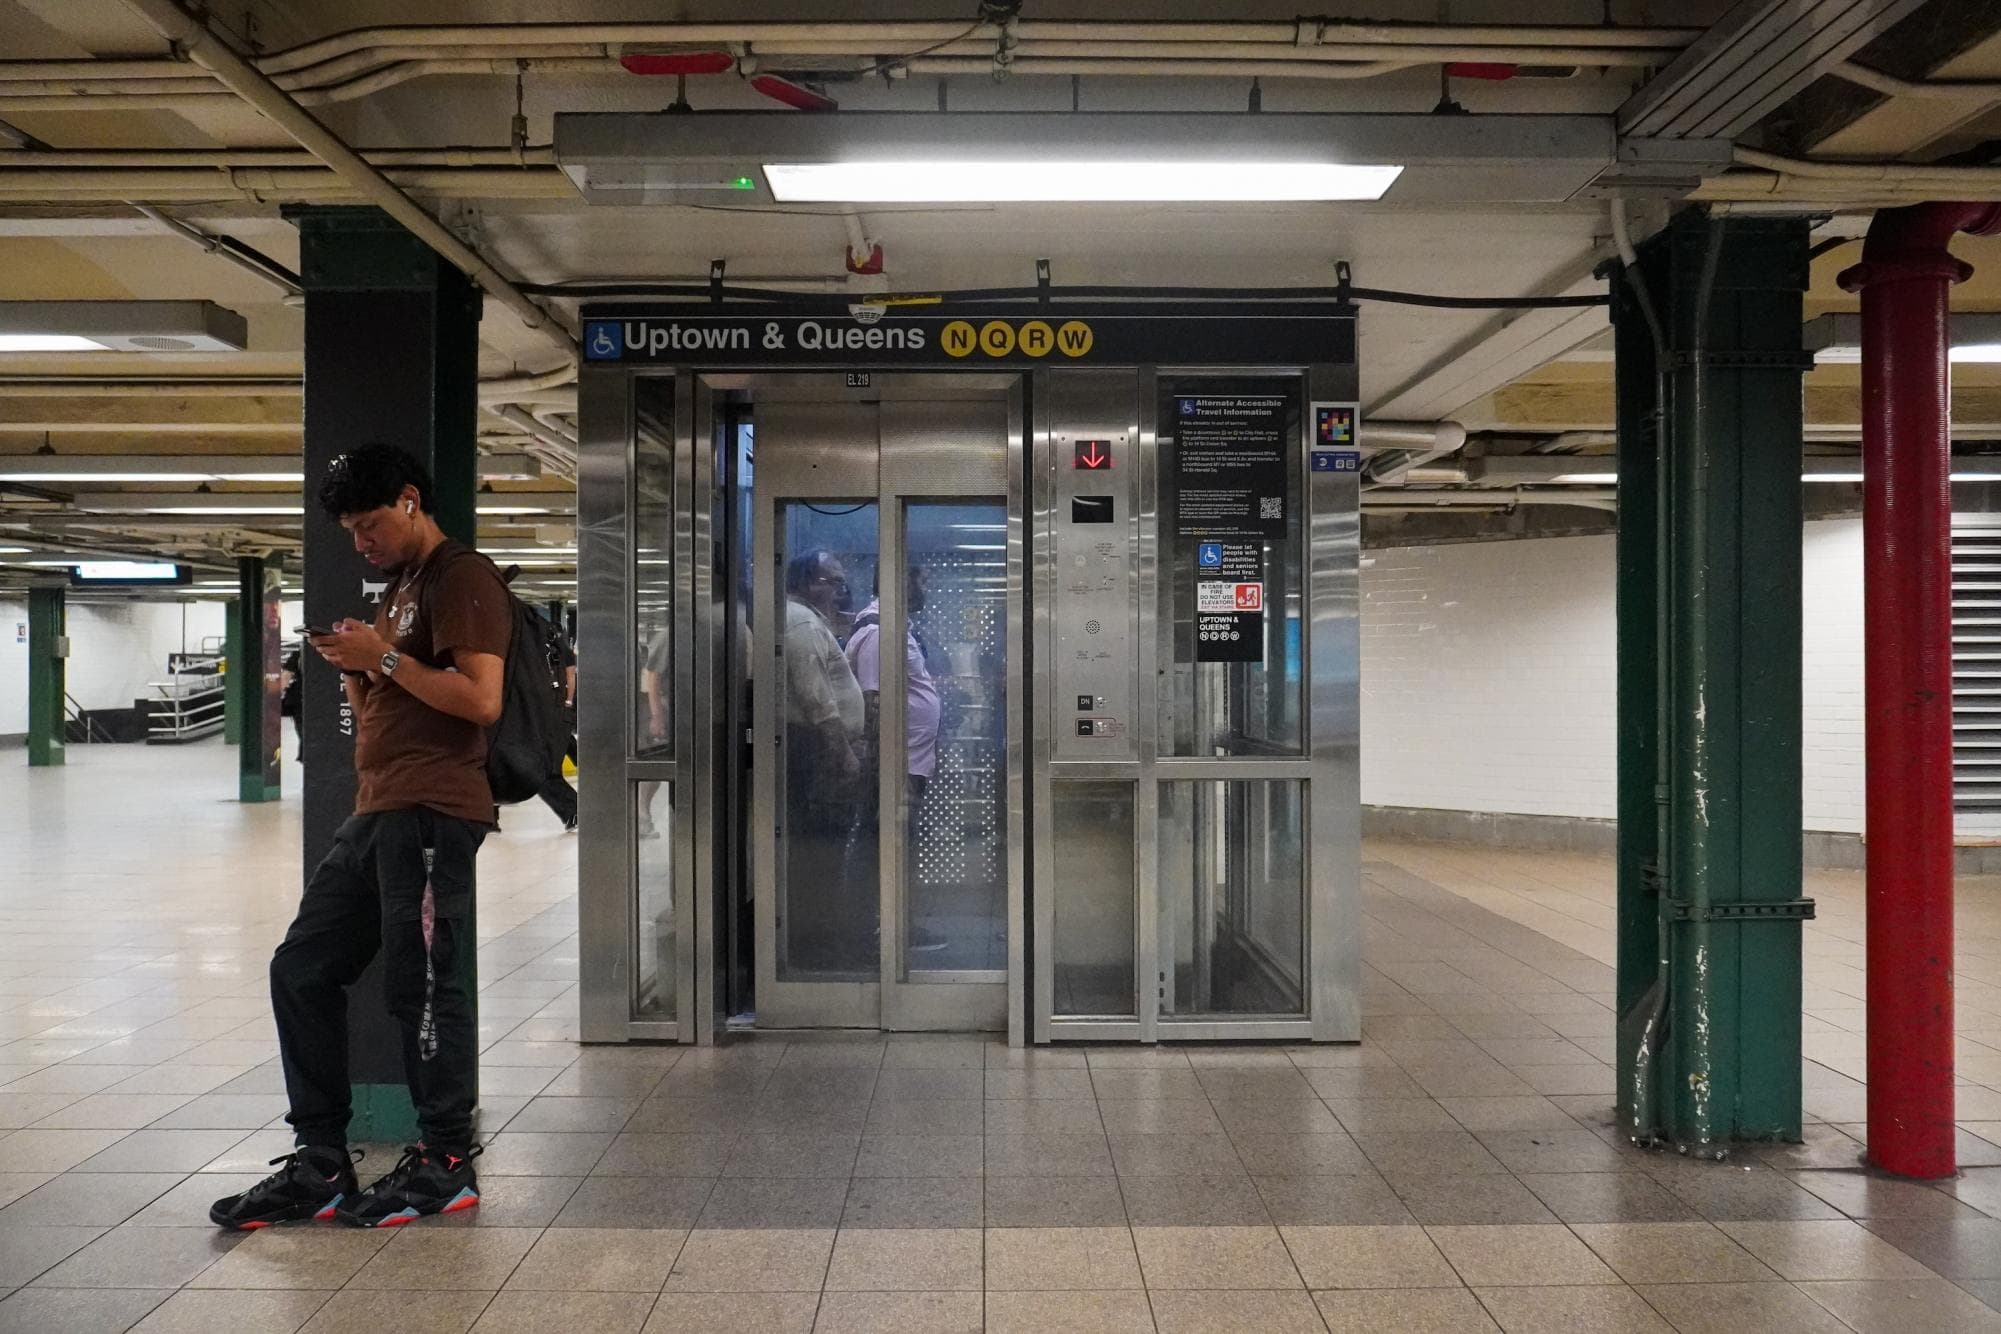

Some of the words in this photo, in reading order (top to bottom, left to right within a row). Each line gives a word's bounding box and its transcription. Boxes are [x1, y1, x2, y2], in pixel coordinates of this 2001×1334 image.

[624, 321, 750, 357] Uptown
[762, 321, 786, 350] &
[797, 320, 926, 350] Queens
[847, 373, 857, 386] EL
[857, 373, 869, 386] 219
[1196, 408, 1222, 416] Travel
[1223, 408, 1272, 416] Information
[339, 702, 352, 736] 1897
